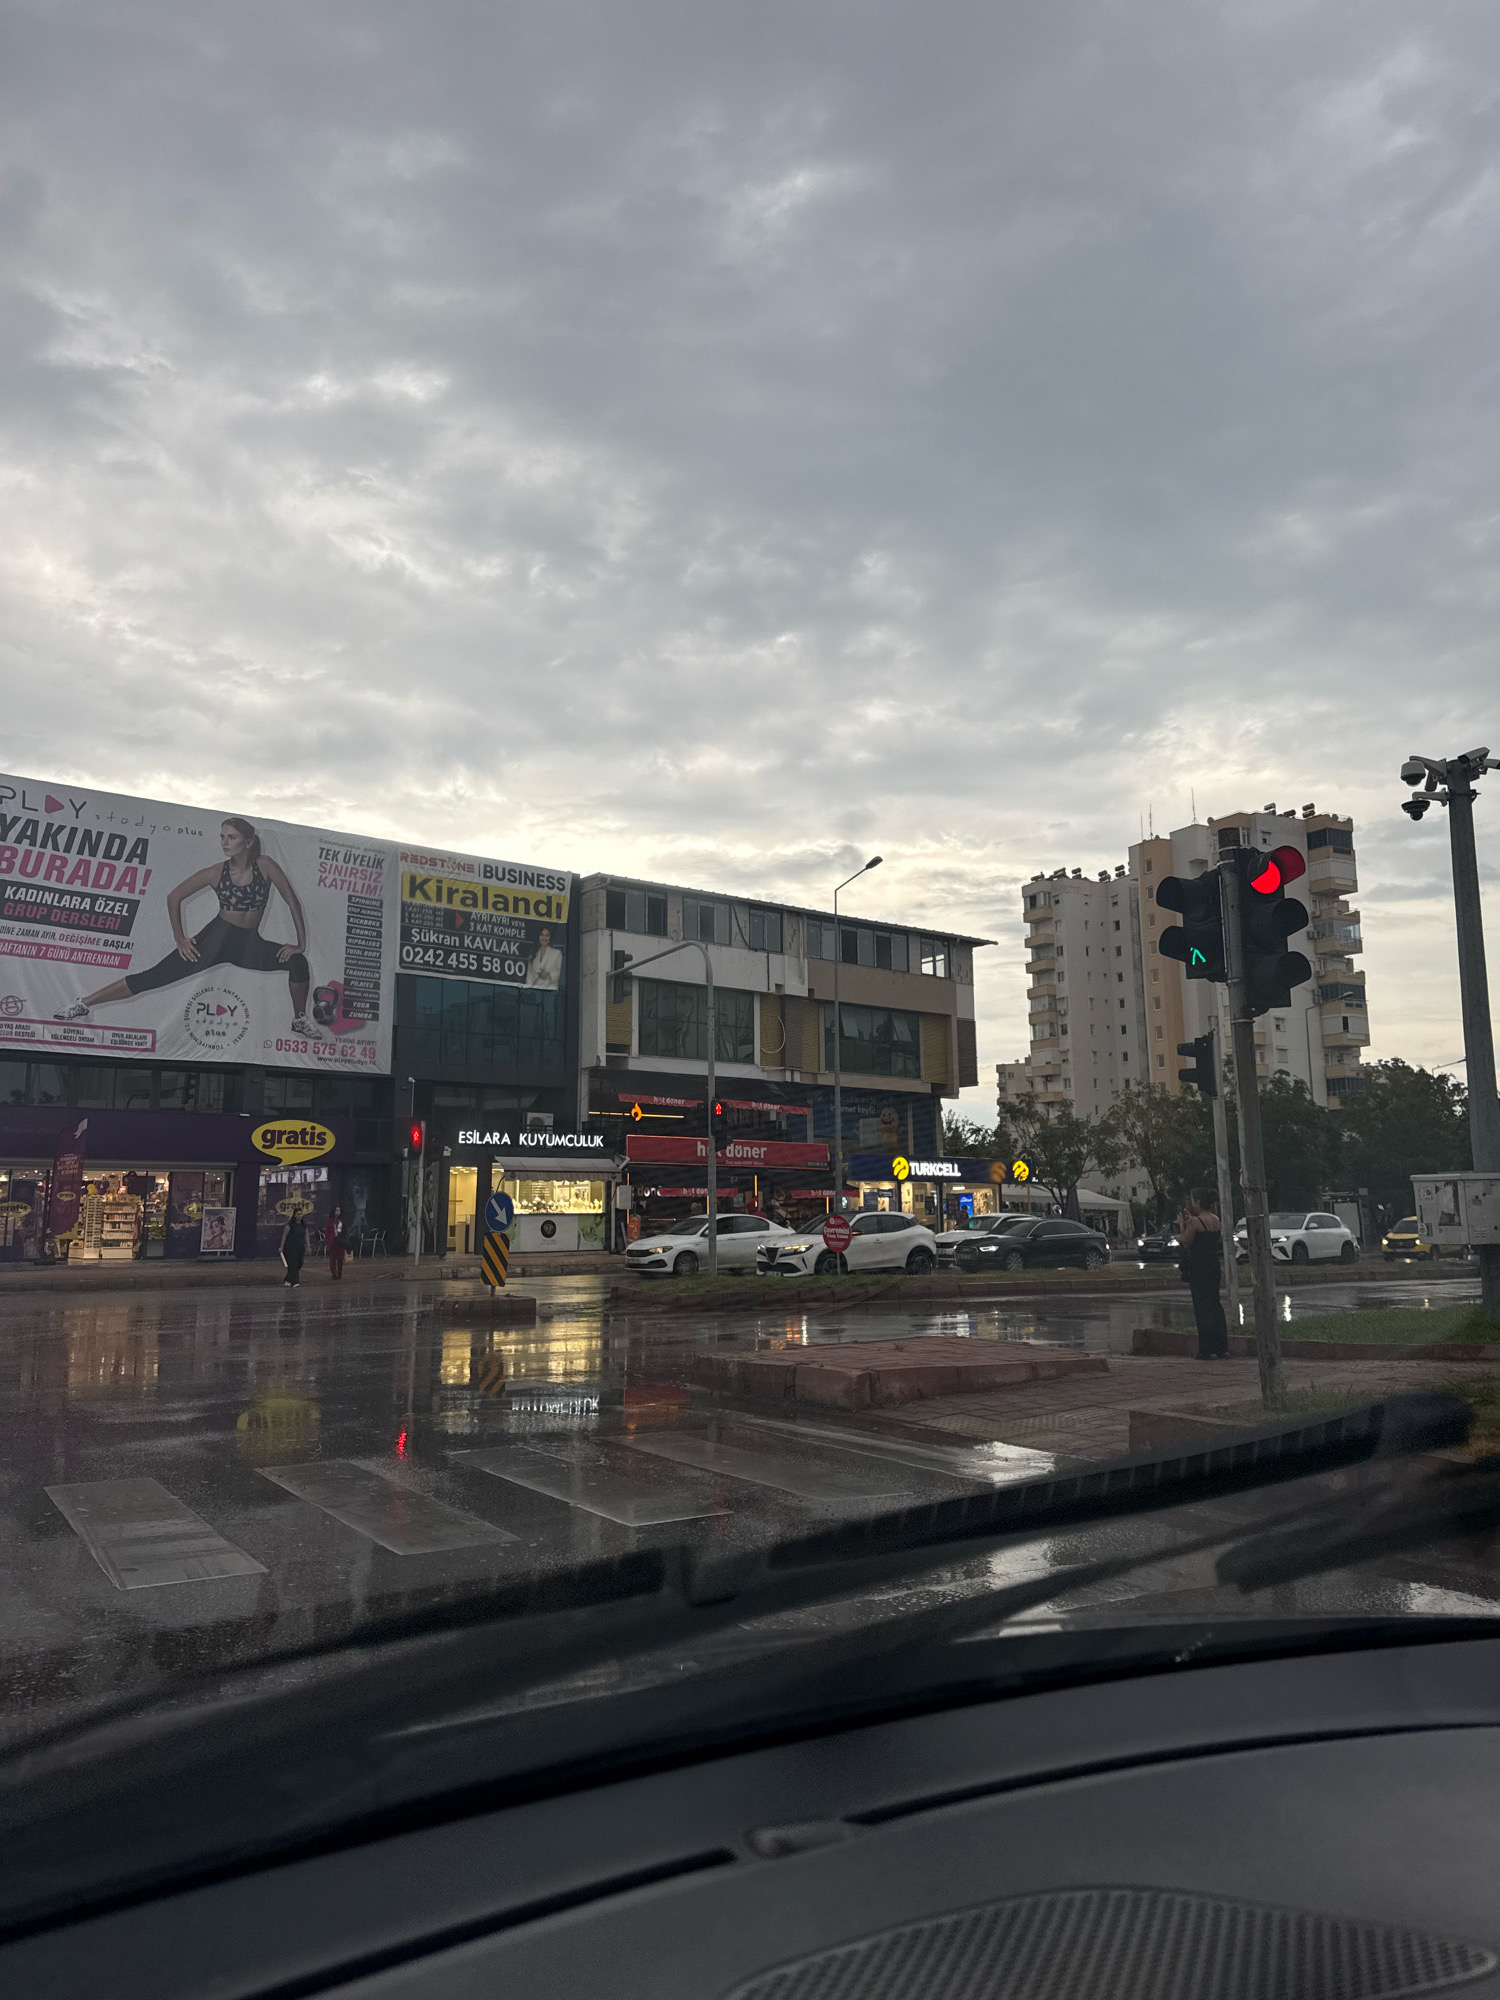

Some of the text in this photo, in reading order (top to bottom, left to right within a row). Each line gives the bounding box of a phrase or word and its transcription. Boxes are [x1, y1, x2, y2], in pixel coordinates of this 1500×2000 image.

[0, 813, 149, 865] YAKINDA
[177, 826, 203, 837] plus
[0, 844, 152, 896] BURADA!
[318, 847, 341, 863] TEK
[342, 849, 385, 870] ÜYELİK
[318, 861, 384, 884] SINIRSIZ
[483, 863, 566, 892] BUSINESS
[317, 875, 383, 897] KATILIM!
[408, 875, 562, 920] Kiralandı
[4, 885, 129, 916] KADINLARA ÖZEL
[3, 902, 121, 930] GRUP DERSLERİ
[470, 912, 526, 928] AYRI AYRI VEYA
[16, 927, 41, 938] ZAMAN
[59, 932, 101, 947] DEĞİŞİME
[102, 939, 135, 950] BAŞLA!
[411, 928, 520, 956] Şükran KAVLAK
[469, 922, 526, 939] 3 KAT KOMPLE
[39, 946, 46, 957] 7
[47, 947, 72, 960] GÜNÜ
[71, 954, 121, 966] ANTRENMAN
[402, 945, 444, 966] 0242
[447, 952, 478, 970] 455
[482, 956, 501, 973] 58
[504, 960, 526, 977] 00
[205, 1029, 226, 1037] plus
[275, 1038, 376, 1059] 0533 575 62 49
[261, 1125, 327, 1149] gratis
[458, 1129, 604, 1148] ESİLARA KUYUMCULUK
[725, 1142, 768, 1159] döner
[909, 1161, 961, 1177] TURKCELL
